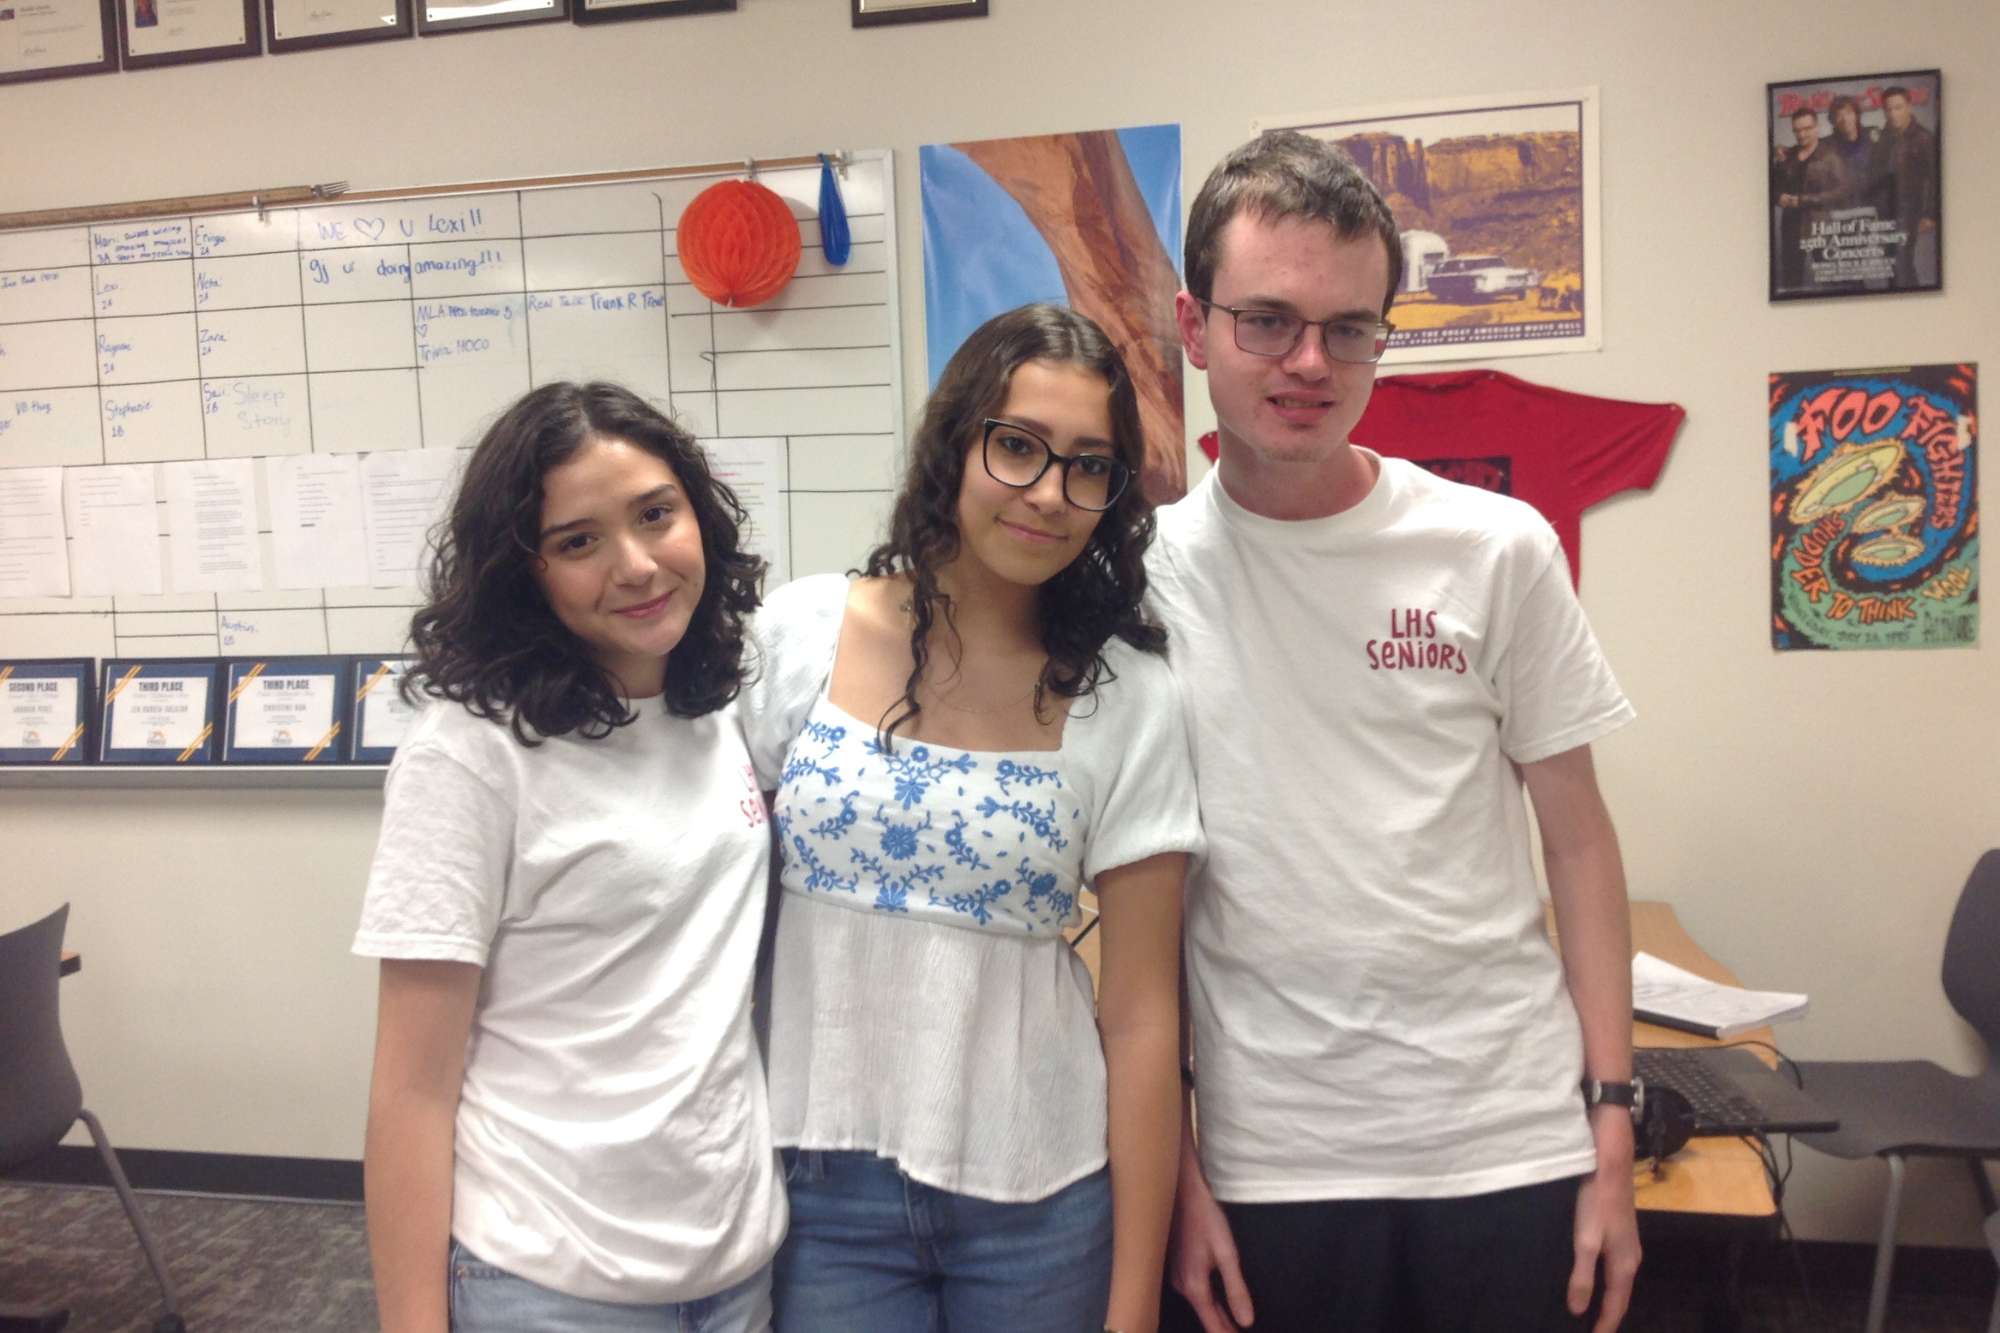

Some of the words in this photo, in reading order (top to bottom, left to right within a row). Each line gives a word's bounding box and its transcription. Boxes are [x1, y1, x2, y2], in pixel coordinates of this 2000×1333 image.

[317, 221, 347, 240] WE
[400, 219, 413, 237] U
[1812, 221, 1841, 236] Hall
[1842, 218, 1859, 233] of
[1859, 217, 1898, 232] Fame
[1829, 232, 1909, 248] Anniversary
[376, 259, 411, 284] doing
[1795, 387, 1902, 463] FOO
[1901, 396, 1966, 531] FIGHTERS
[1921, 566, 1972, 601] WOOL
[1826, 592, 1855, 620] TO
[1857, 597, 1917, 625] THINK
[1391, 608, 1437, 639] LHS
[9, 682, 35, 692] SECOND
[37, 682, 58, 692] PLACE
[139, 682, 159, 691] THIRD
[161, 682, 183, 691] PLACE
[263, 680, 284, 690] THIRD
[287, 680, 309, 690] PLACE
